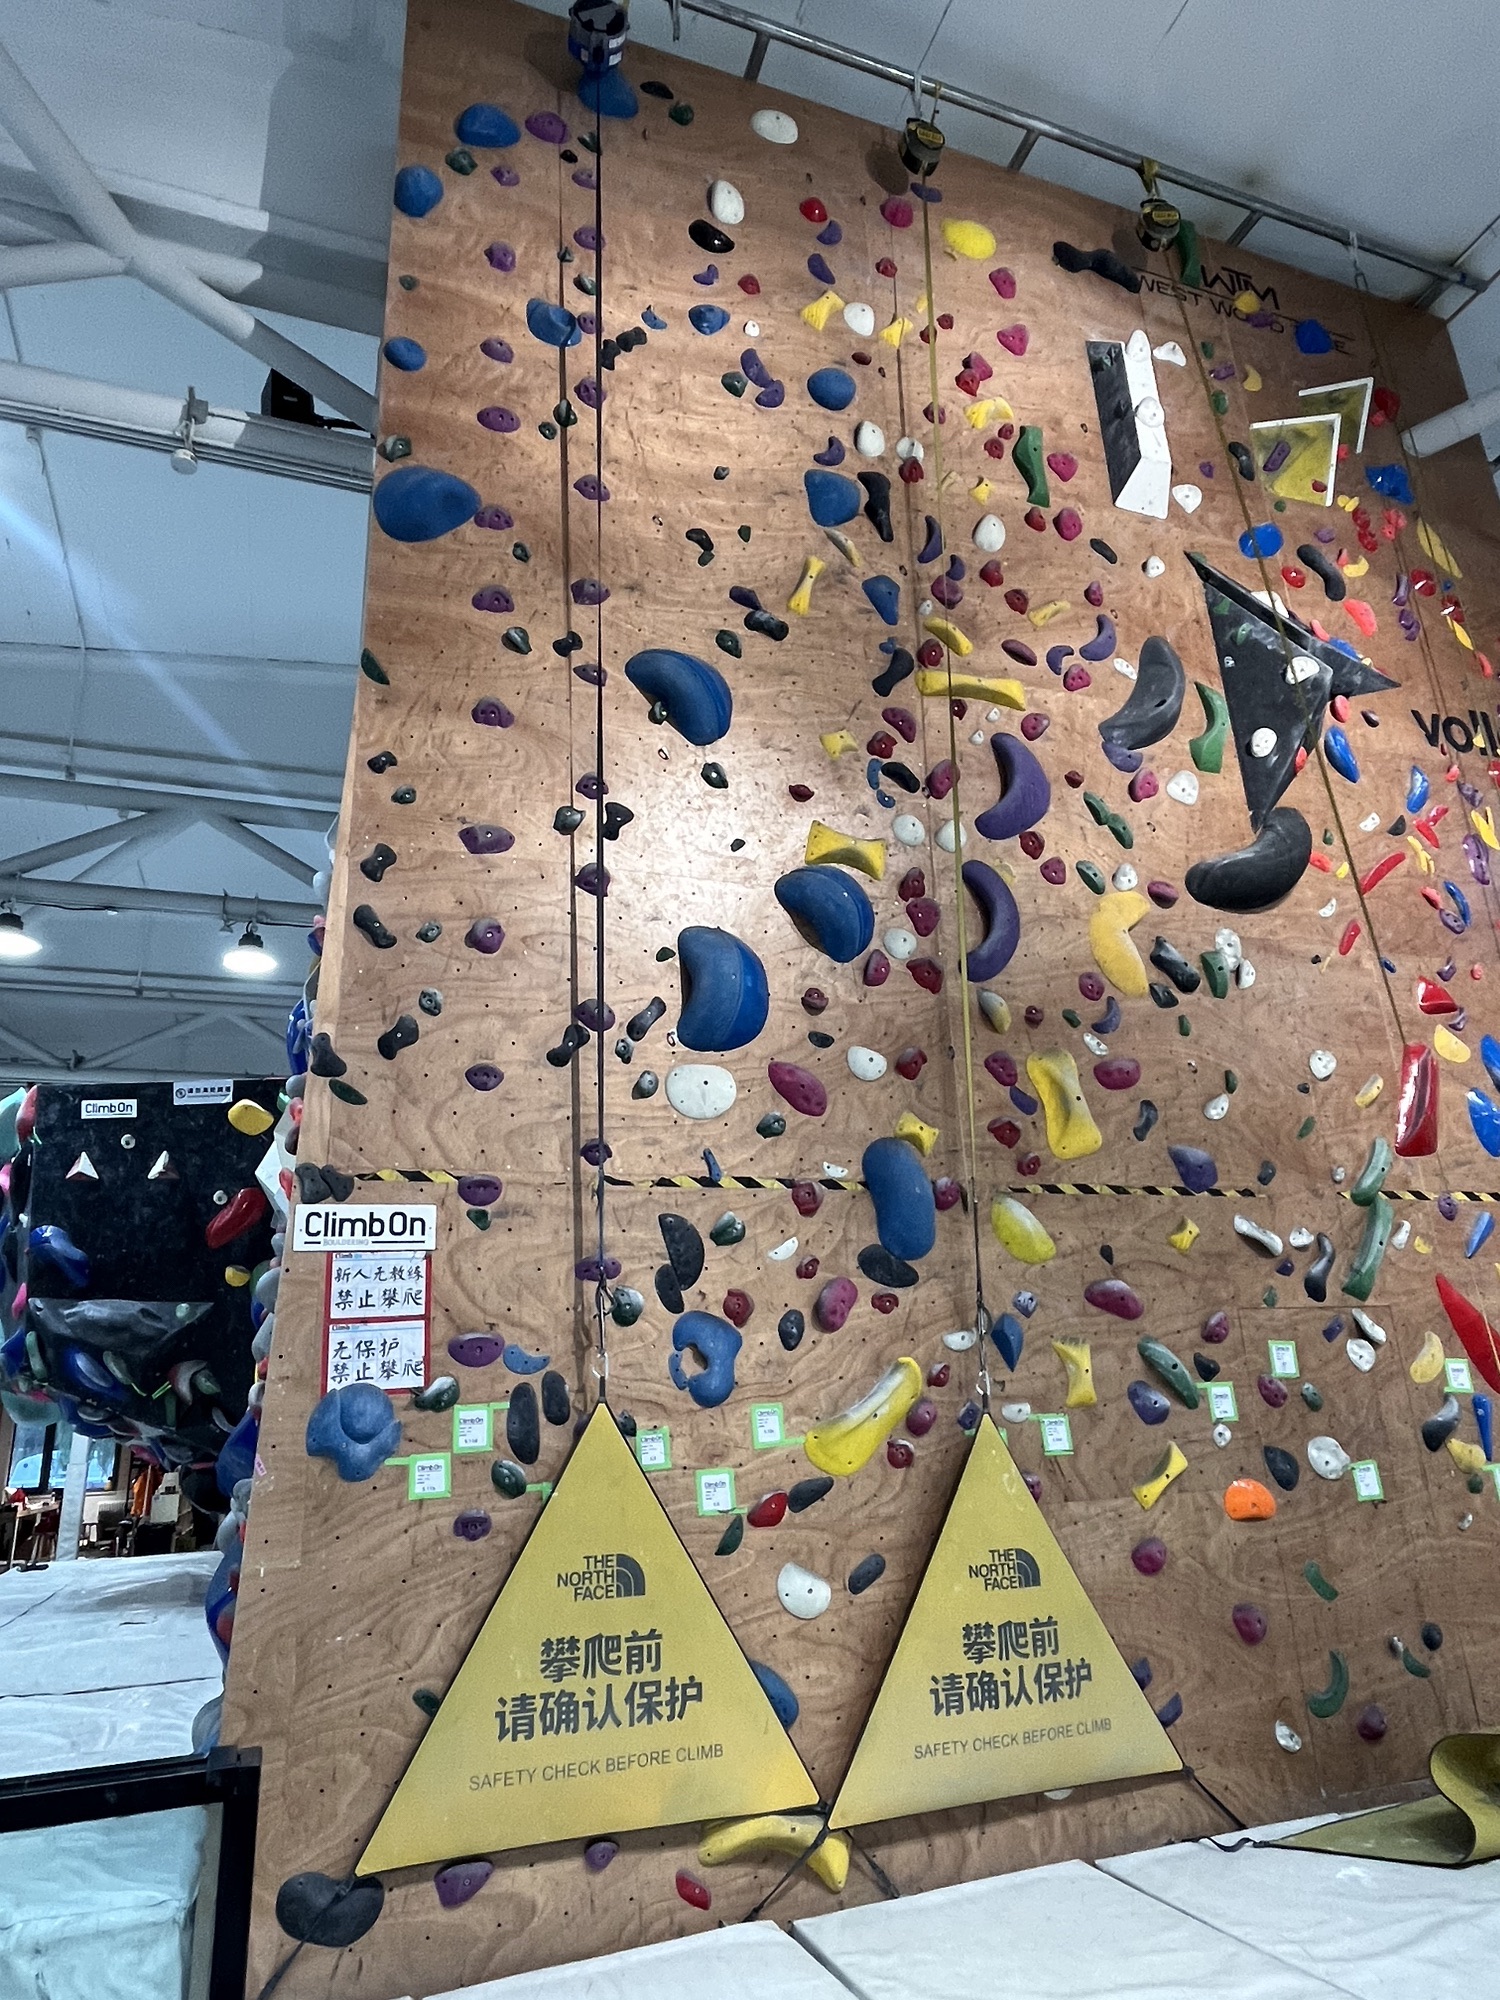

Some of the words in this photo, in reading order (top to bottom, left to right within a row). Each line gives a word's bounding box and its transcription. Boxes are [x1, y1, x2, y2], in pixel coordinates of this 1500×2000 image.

[1209, 297, 1284, 334] WOD
[334, 1265, 424, 1283] 新人无教练
[334, 1287, 423, 1311] 禁止攀爬
[332, 1337, 400, 1360] 无保护
[330, 1358, 424, 1384] 禁止攀爬
[583, 1553, 615, 1569] THE
[988, 1548, 1015, 1562] THE
[557, 1569, 615, 1588] NORTH
[968, 1562, 1016, 1579] NORTH
[574, 1585, 615, 1602] FACE
[984, 1575, 1018, 1591] FACE
[962, 1615, 1059, 1665] 攀爬前
[540, 1628, 663, 1683] 攀爬前
[929, 1657, 1092, 1717] 请确认保护
[495, 1675, 703, 1743] 请确认保护
[914, 1739, 969, 1760] SAFETY
[972, 1732, 1020, 1752] CHECK
[1022, 1724, 1073, 1745] BEFORE
[1077, 1717, 1112, 1735] CLIMB
[469, 1767, 537, 1791] SAFETY
[542, 1759, 601, 1782] CHECK
[605, 1749, 671, 1773] BEFORE
[676, 1743, 724, 1763] CLIMB
